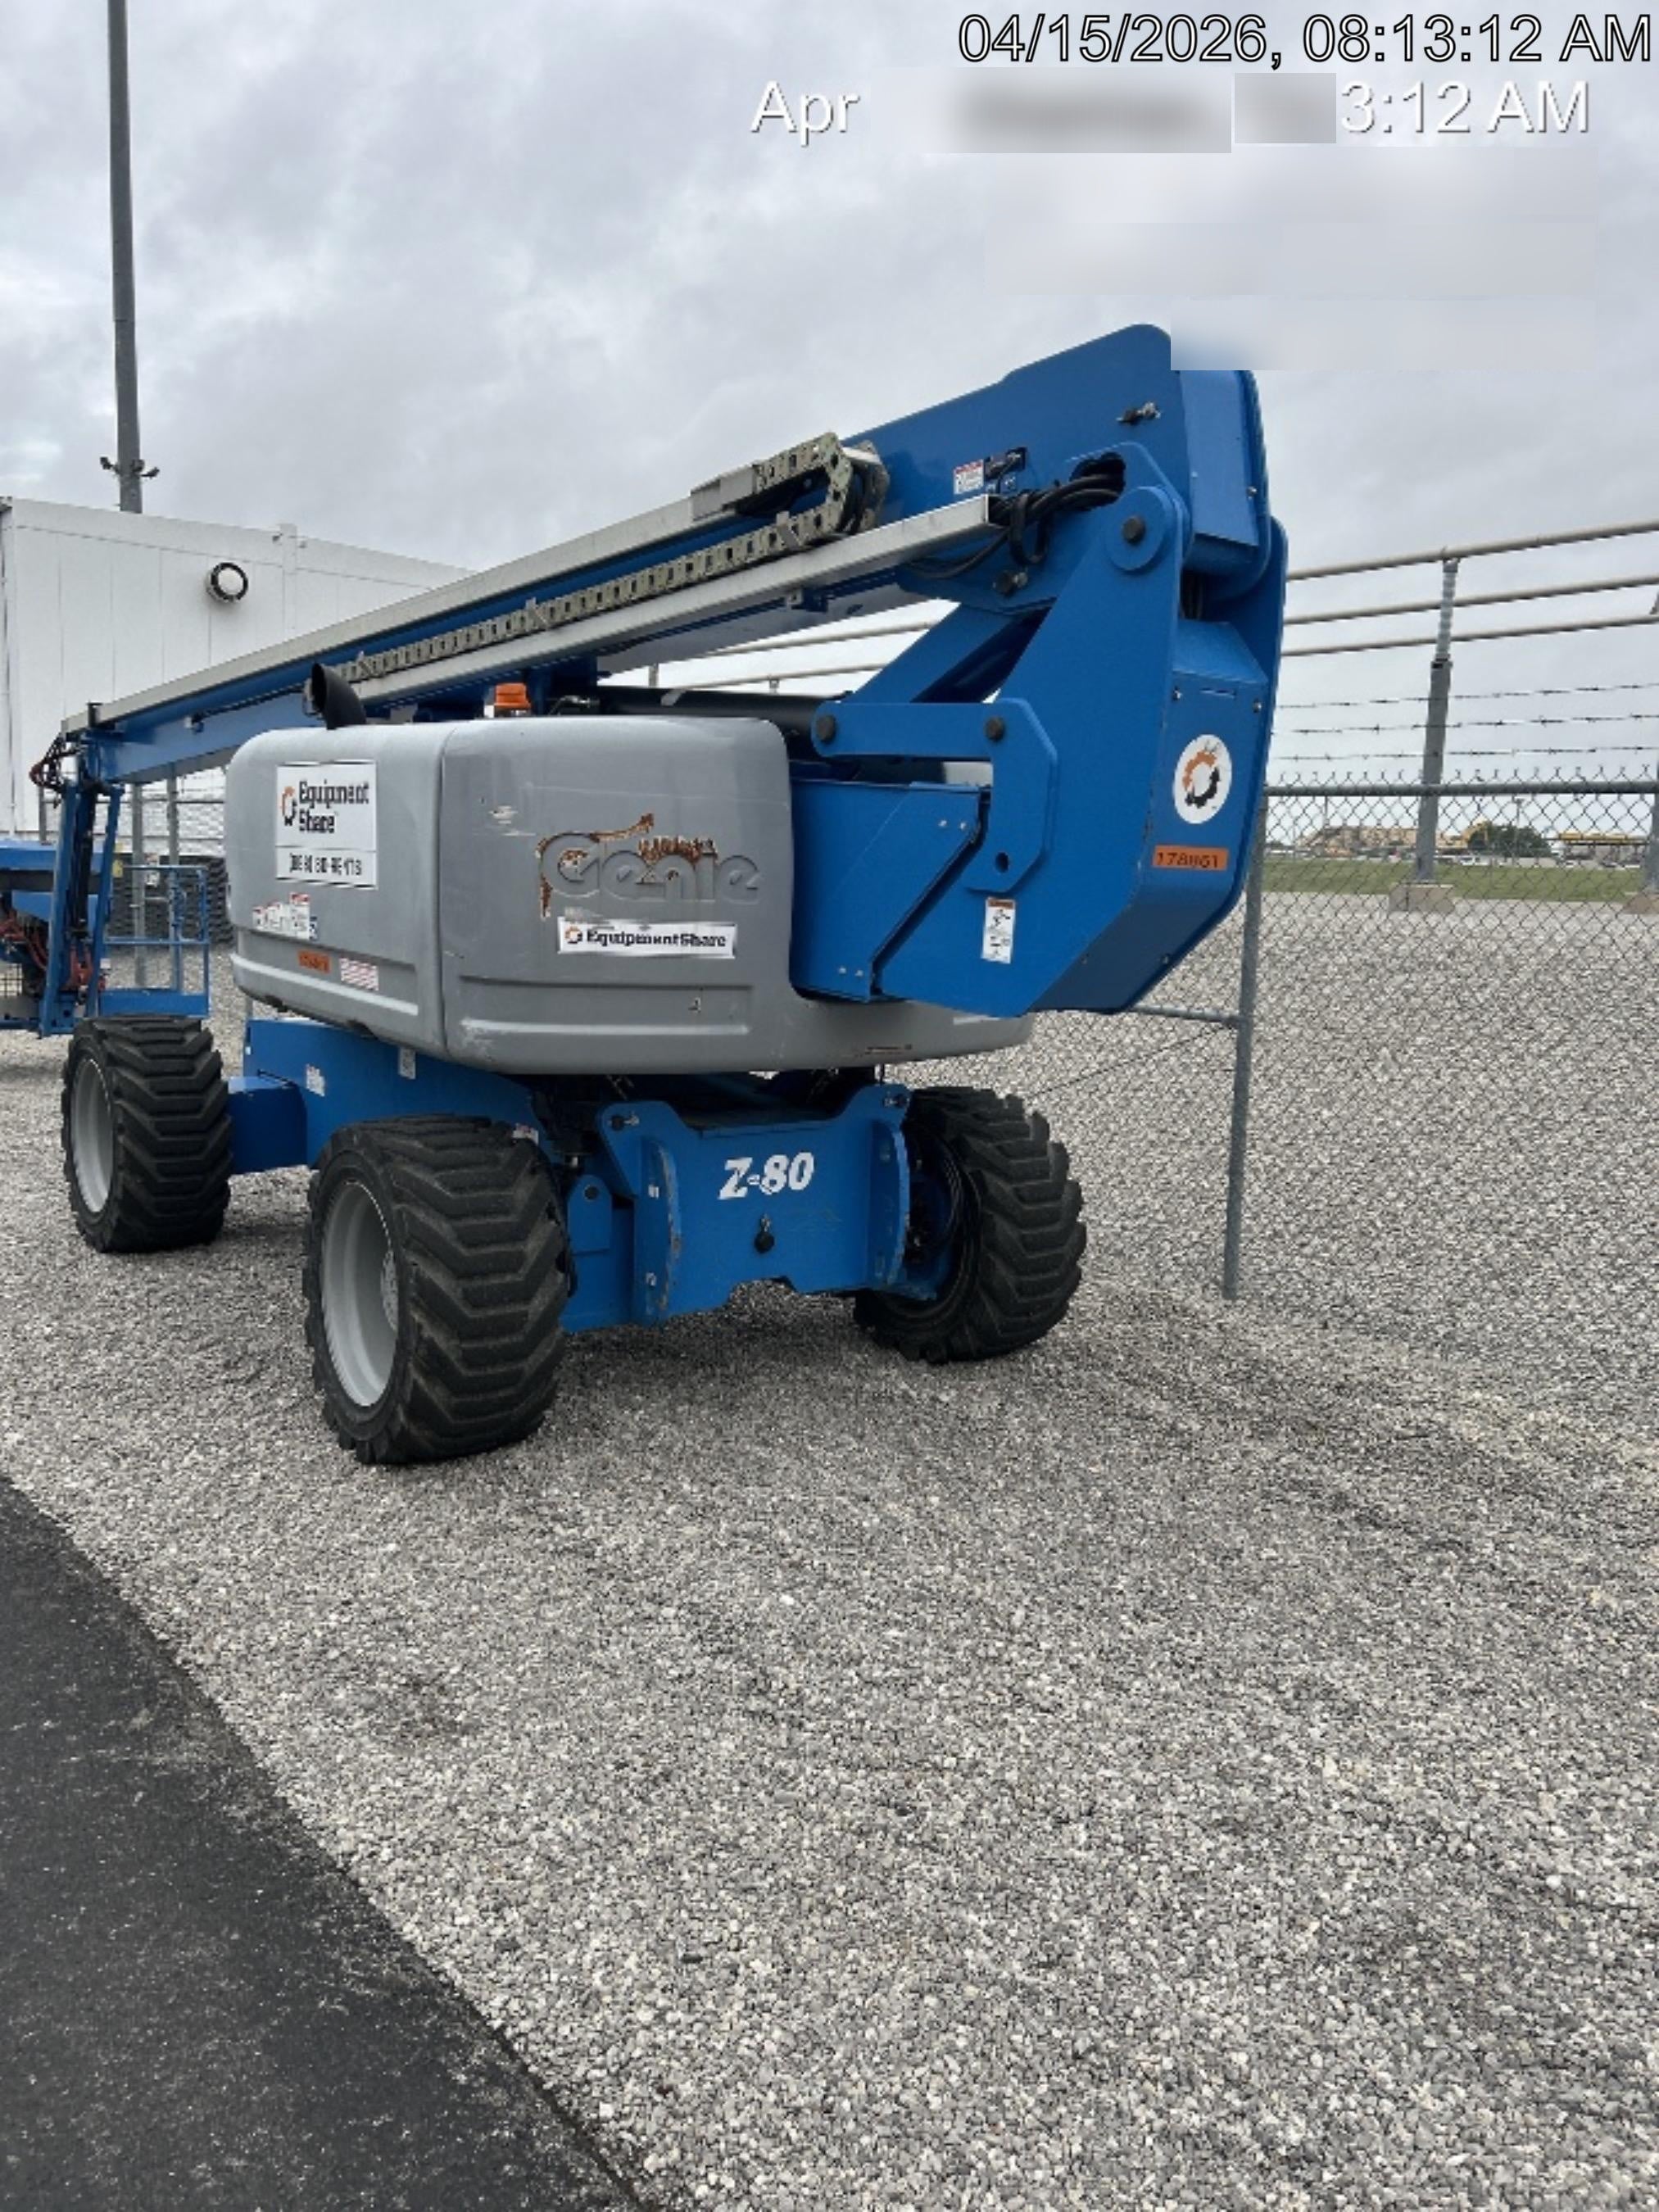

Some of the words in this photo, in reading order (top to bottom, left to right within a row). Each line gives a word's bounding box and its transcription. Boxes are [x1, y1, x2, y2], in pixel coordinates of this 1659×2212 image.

[299, 779, 369, 809] Equipment
[299, 809, 334, 833] Share
[541, 832, 760, 903] Genie
[587, 930, 727, 947] EquipmentShare
[717, 1152, 815, 1200] Z-80
